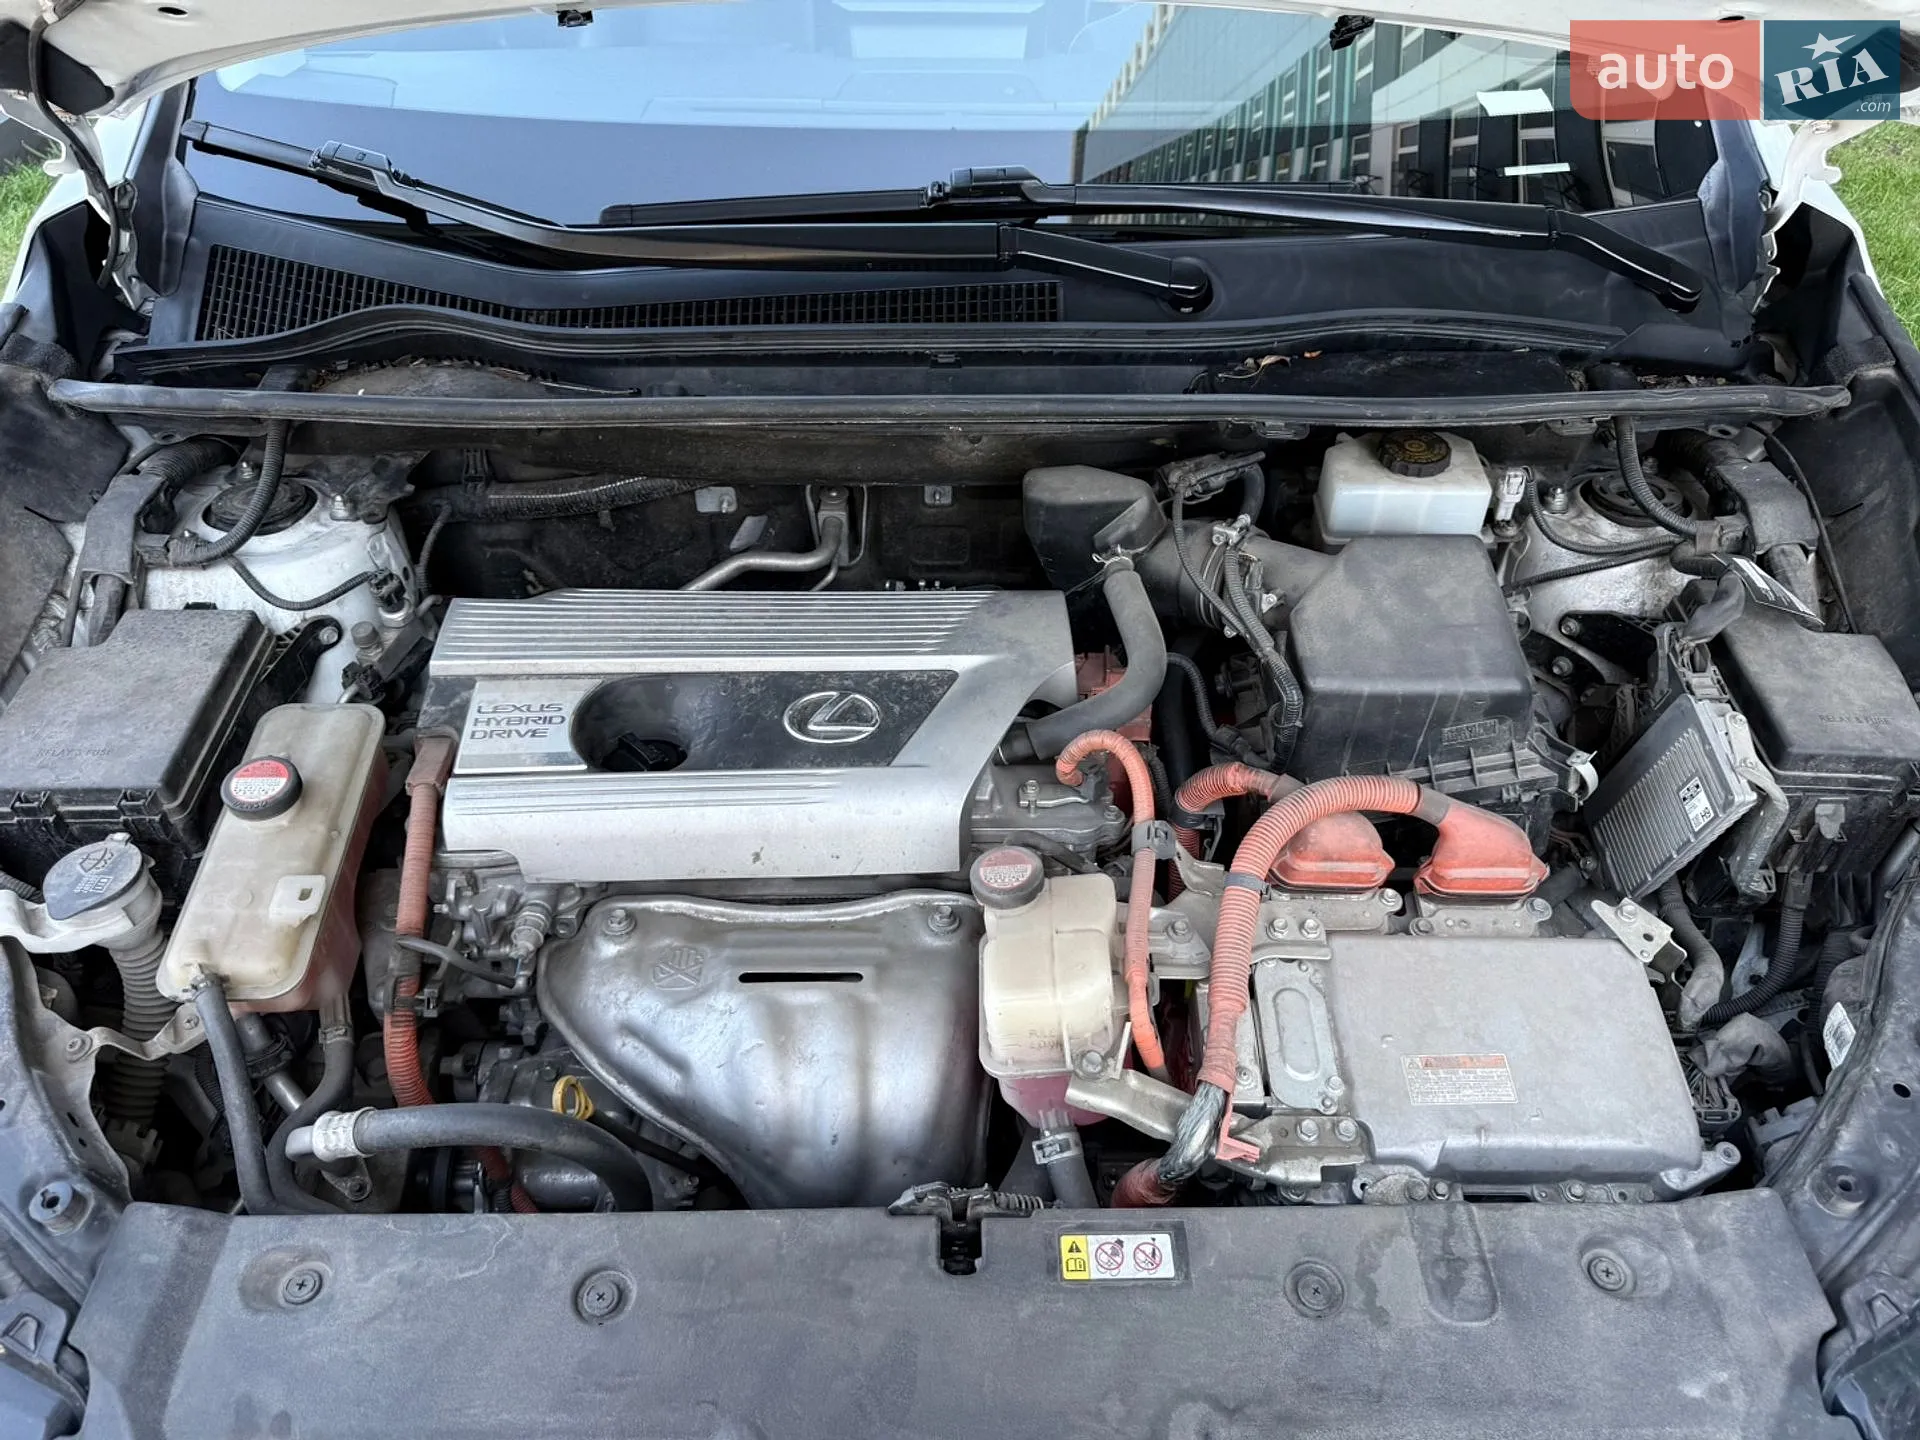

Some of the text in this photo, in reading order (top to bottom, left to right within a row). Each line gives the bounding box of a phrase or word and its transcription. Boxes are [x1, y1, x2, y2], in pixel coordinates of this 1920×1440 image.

[476, 703, 564, 715] LEXUS
[473, 715, 566, 727] HYBRID
[470, 727, 550, 740] DRIVE
